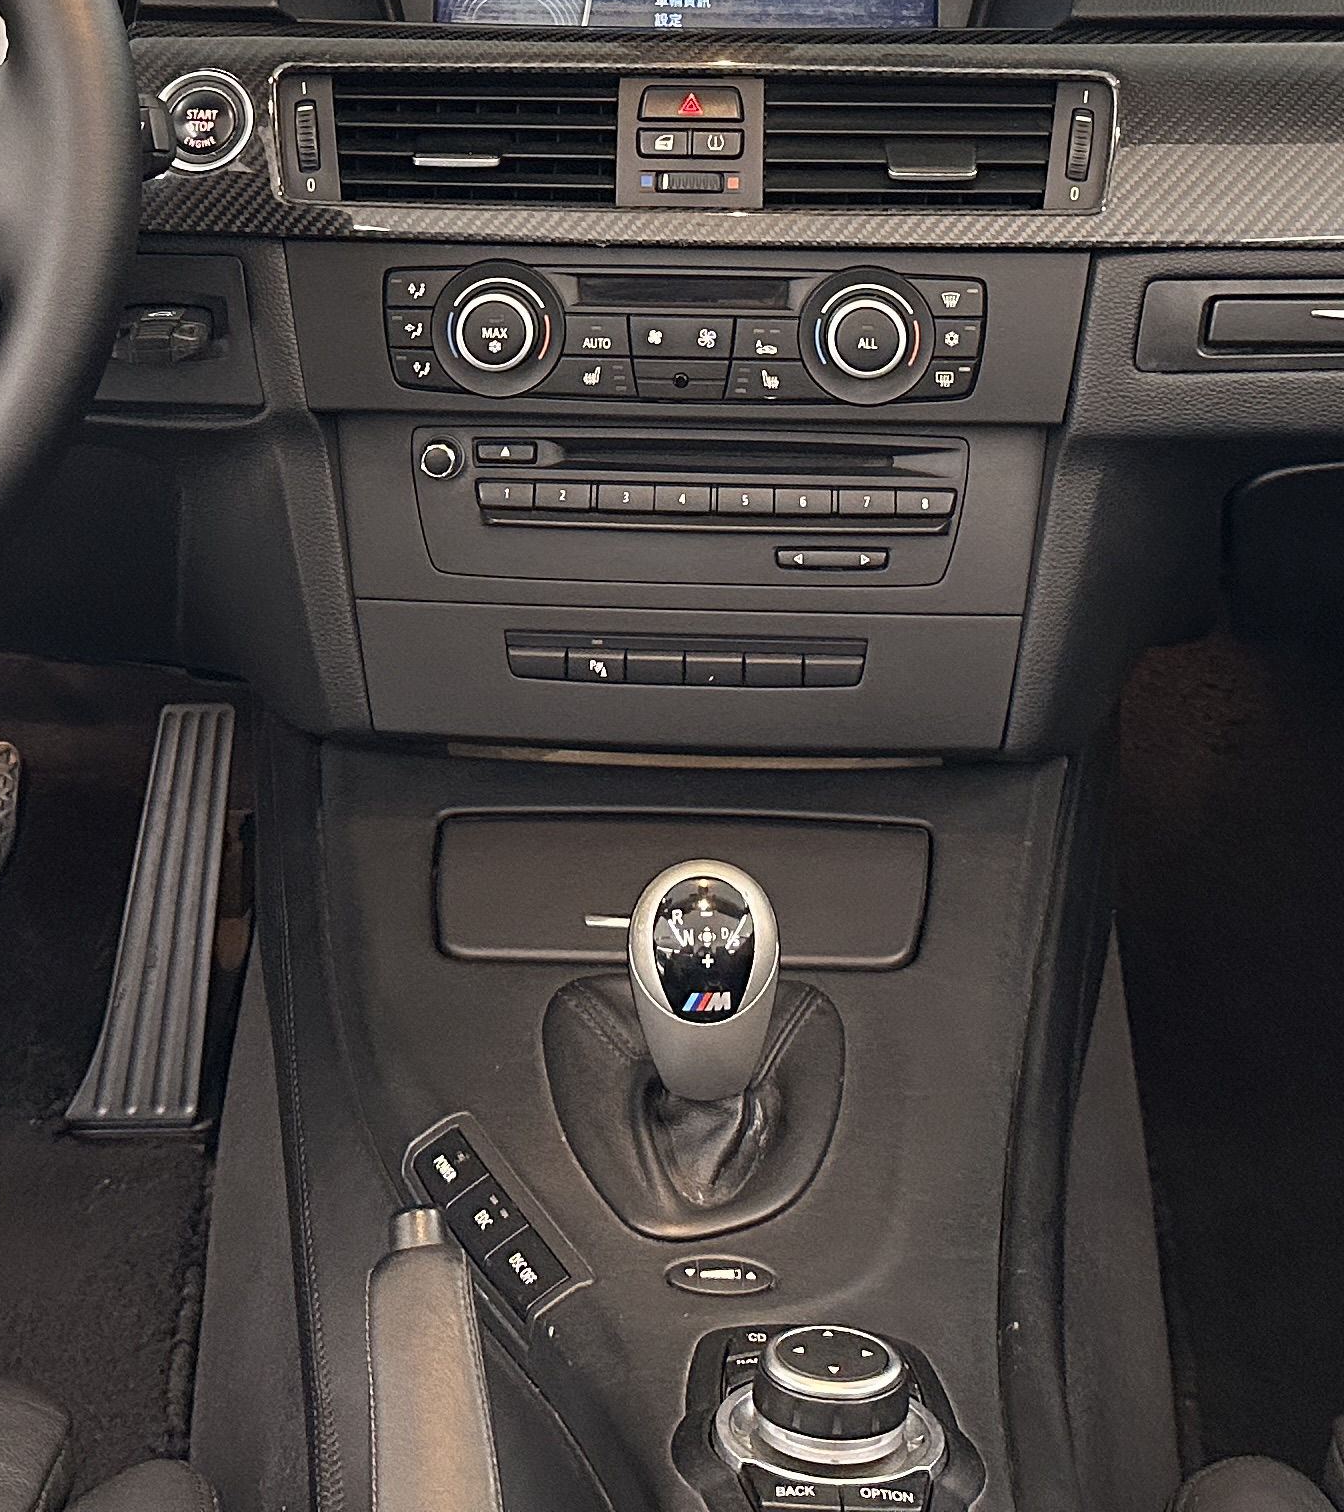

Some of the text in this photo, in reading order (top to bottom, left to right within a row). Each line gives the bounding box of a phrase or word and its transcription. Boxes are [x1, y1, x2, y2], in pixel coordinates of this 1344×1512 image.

[654, 13, 683, 28] 設定
[186, 108, 219, 120] START
[187, 120, 215, 132] STOP
[183, 136, 217, 149] ENGINE
[481, 327, 509, 339] MAX
[582, 337, 612, 349] AUTO
[857, 337, 878, 349] ALL
[504, 487, 510, 499] 1
[559, 489, 566, 501] 2
[622, 491, 630, 503] 3
[678, 493, 686, 505] 4
[741, 494, 749, 506] 5
[799, 495, 807, 508] 6
[863, 495, 871, 508] 7
[921, 497, 929, 509] 8
[432, 1154, 458, 1183] POWER
[473, 1209, 494, 1231] EDC
[508, 1252, 539, 1285] DSC OFF
[747, 1333, 767, 1343] CD
[775, 1485, 815, 1497] BACK
[859, 1487, 914, 1504] OPTION
